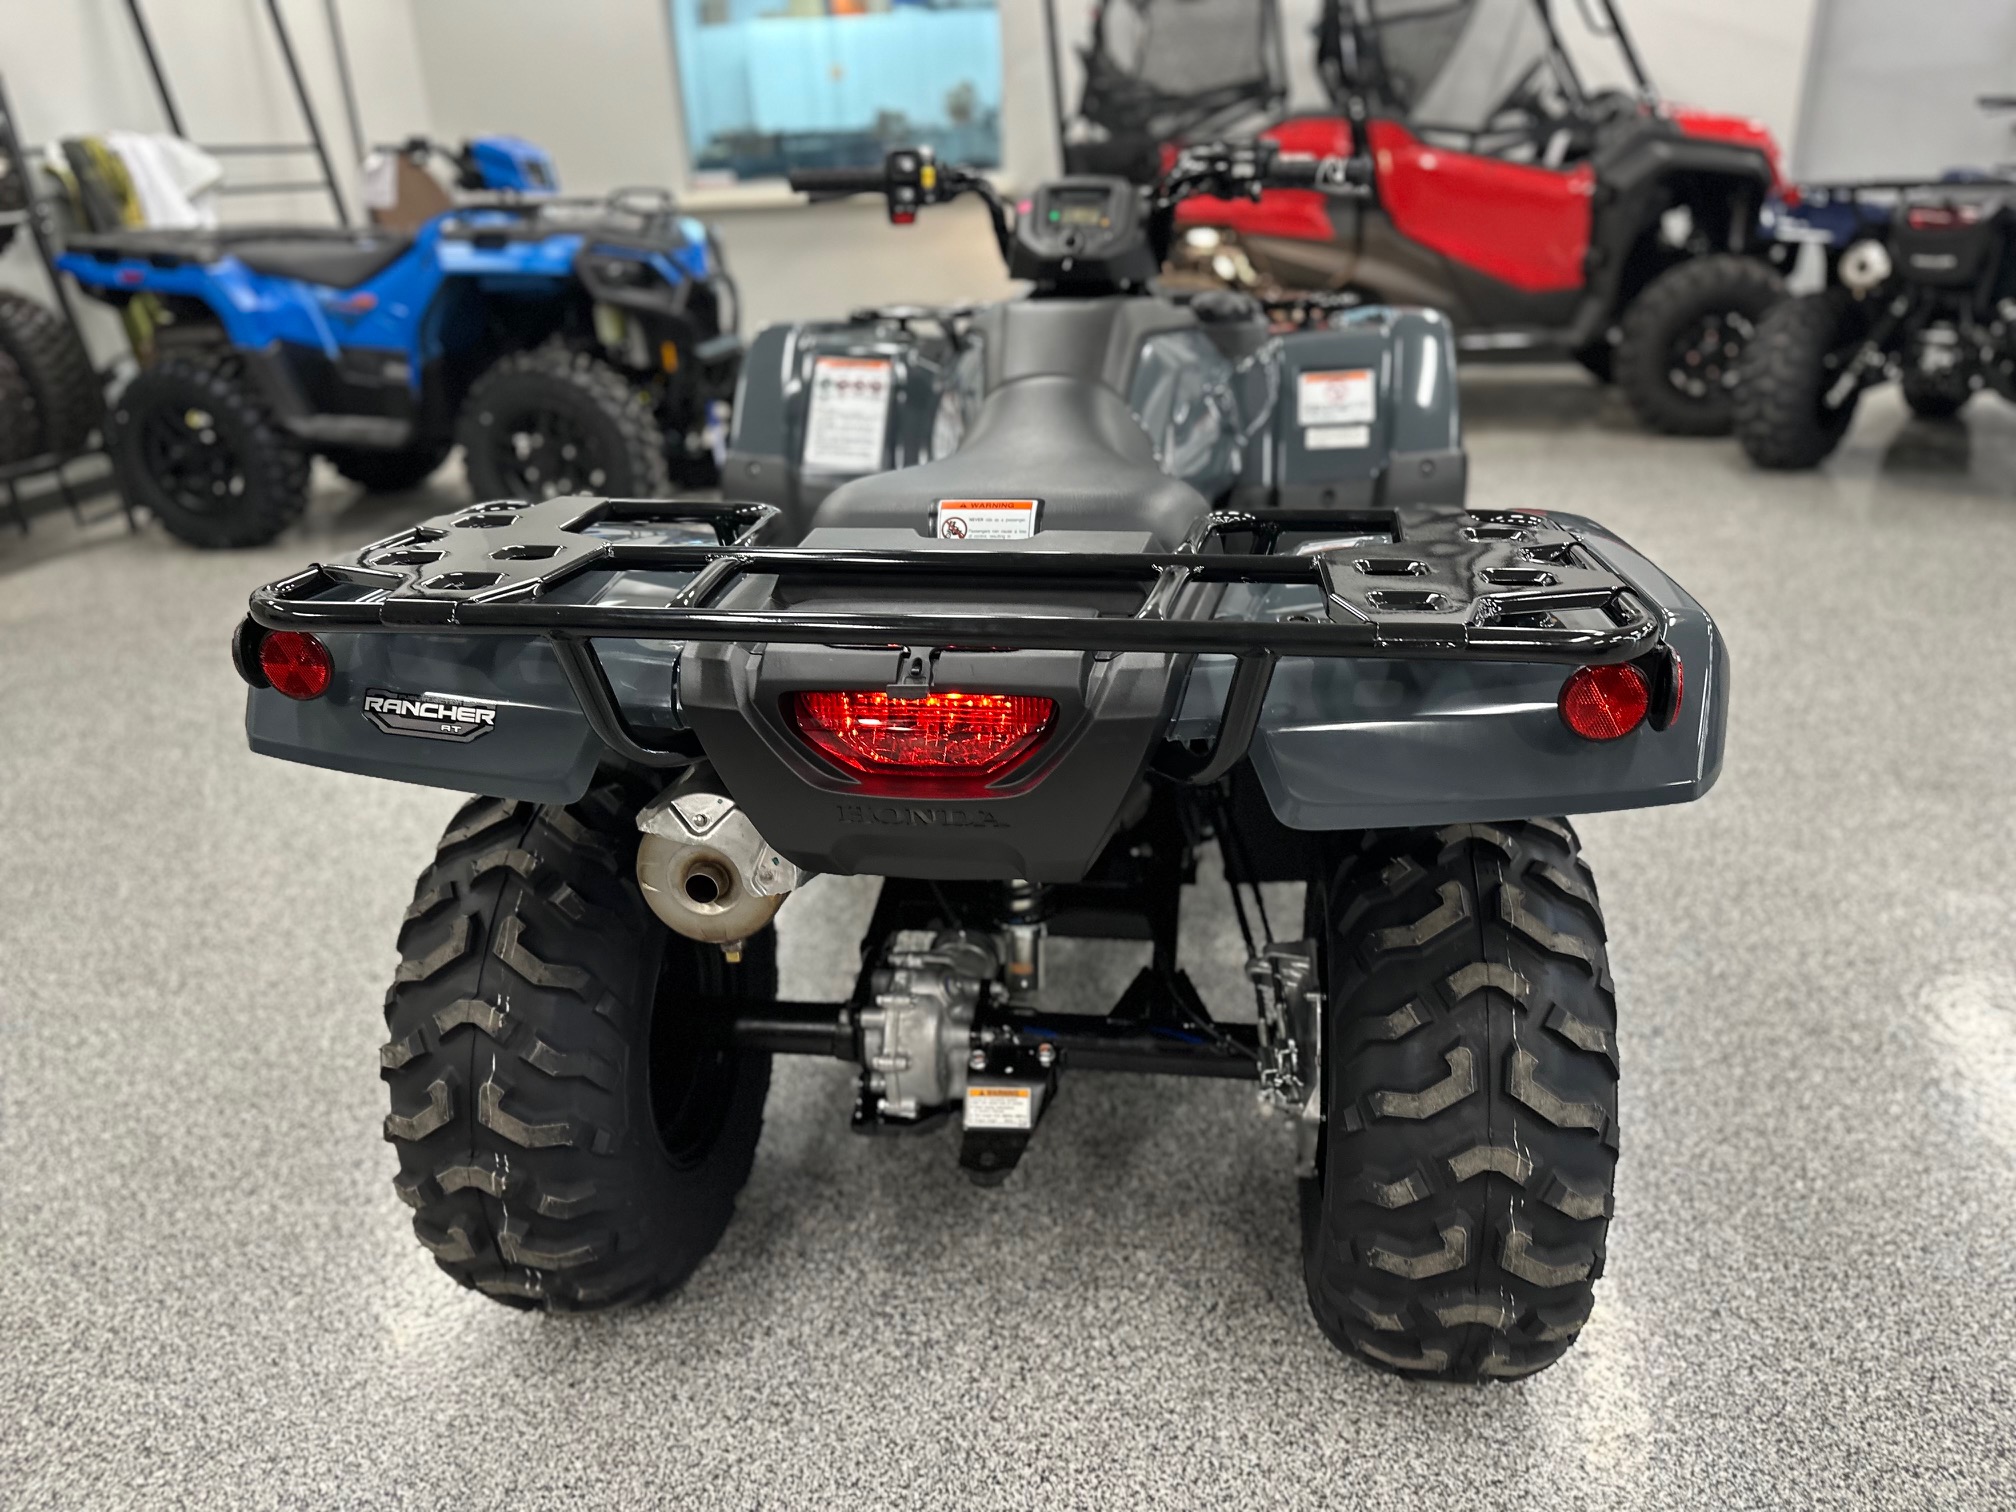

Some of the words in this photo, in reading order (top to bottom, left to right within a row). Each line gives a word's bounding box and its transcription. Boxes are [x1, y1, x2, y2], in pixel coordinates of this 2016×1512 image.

[364, 696, 496, 725] RANCHER
[441, 724, 462, 733] AT
[836, 805, 1011, 828] HONDA
